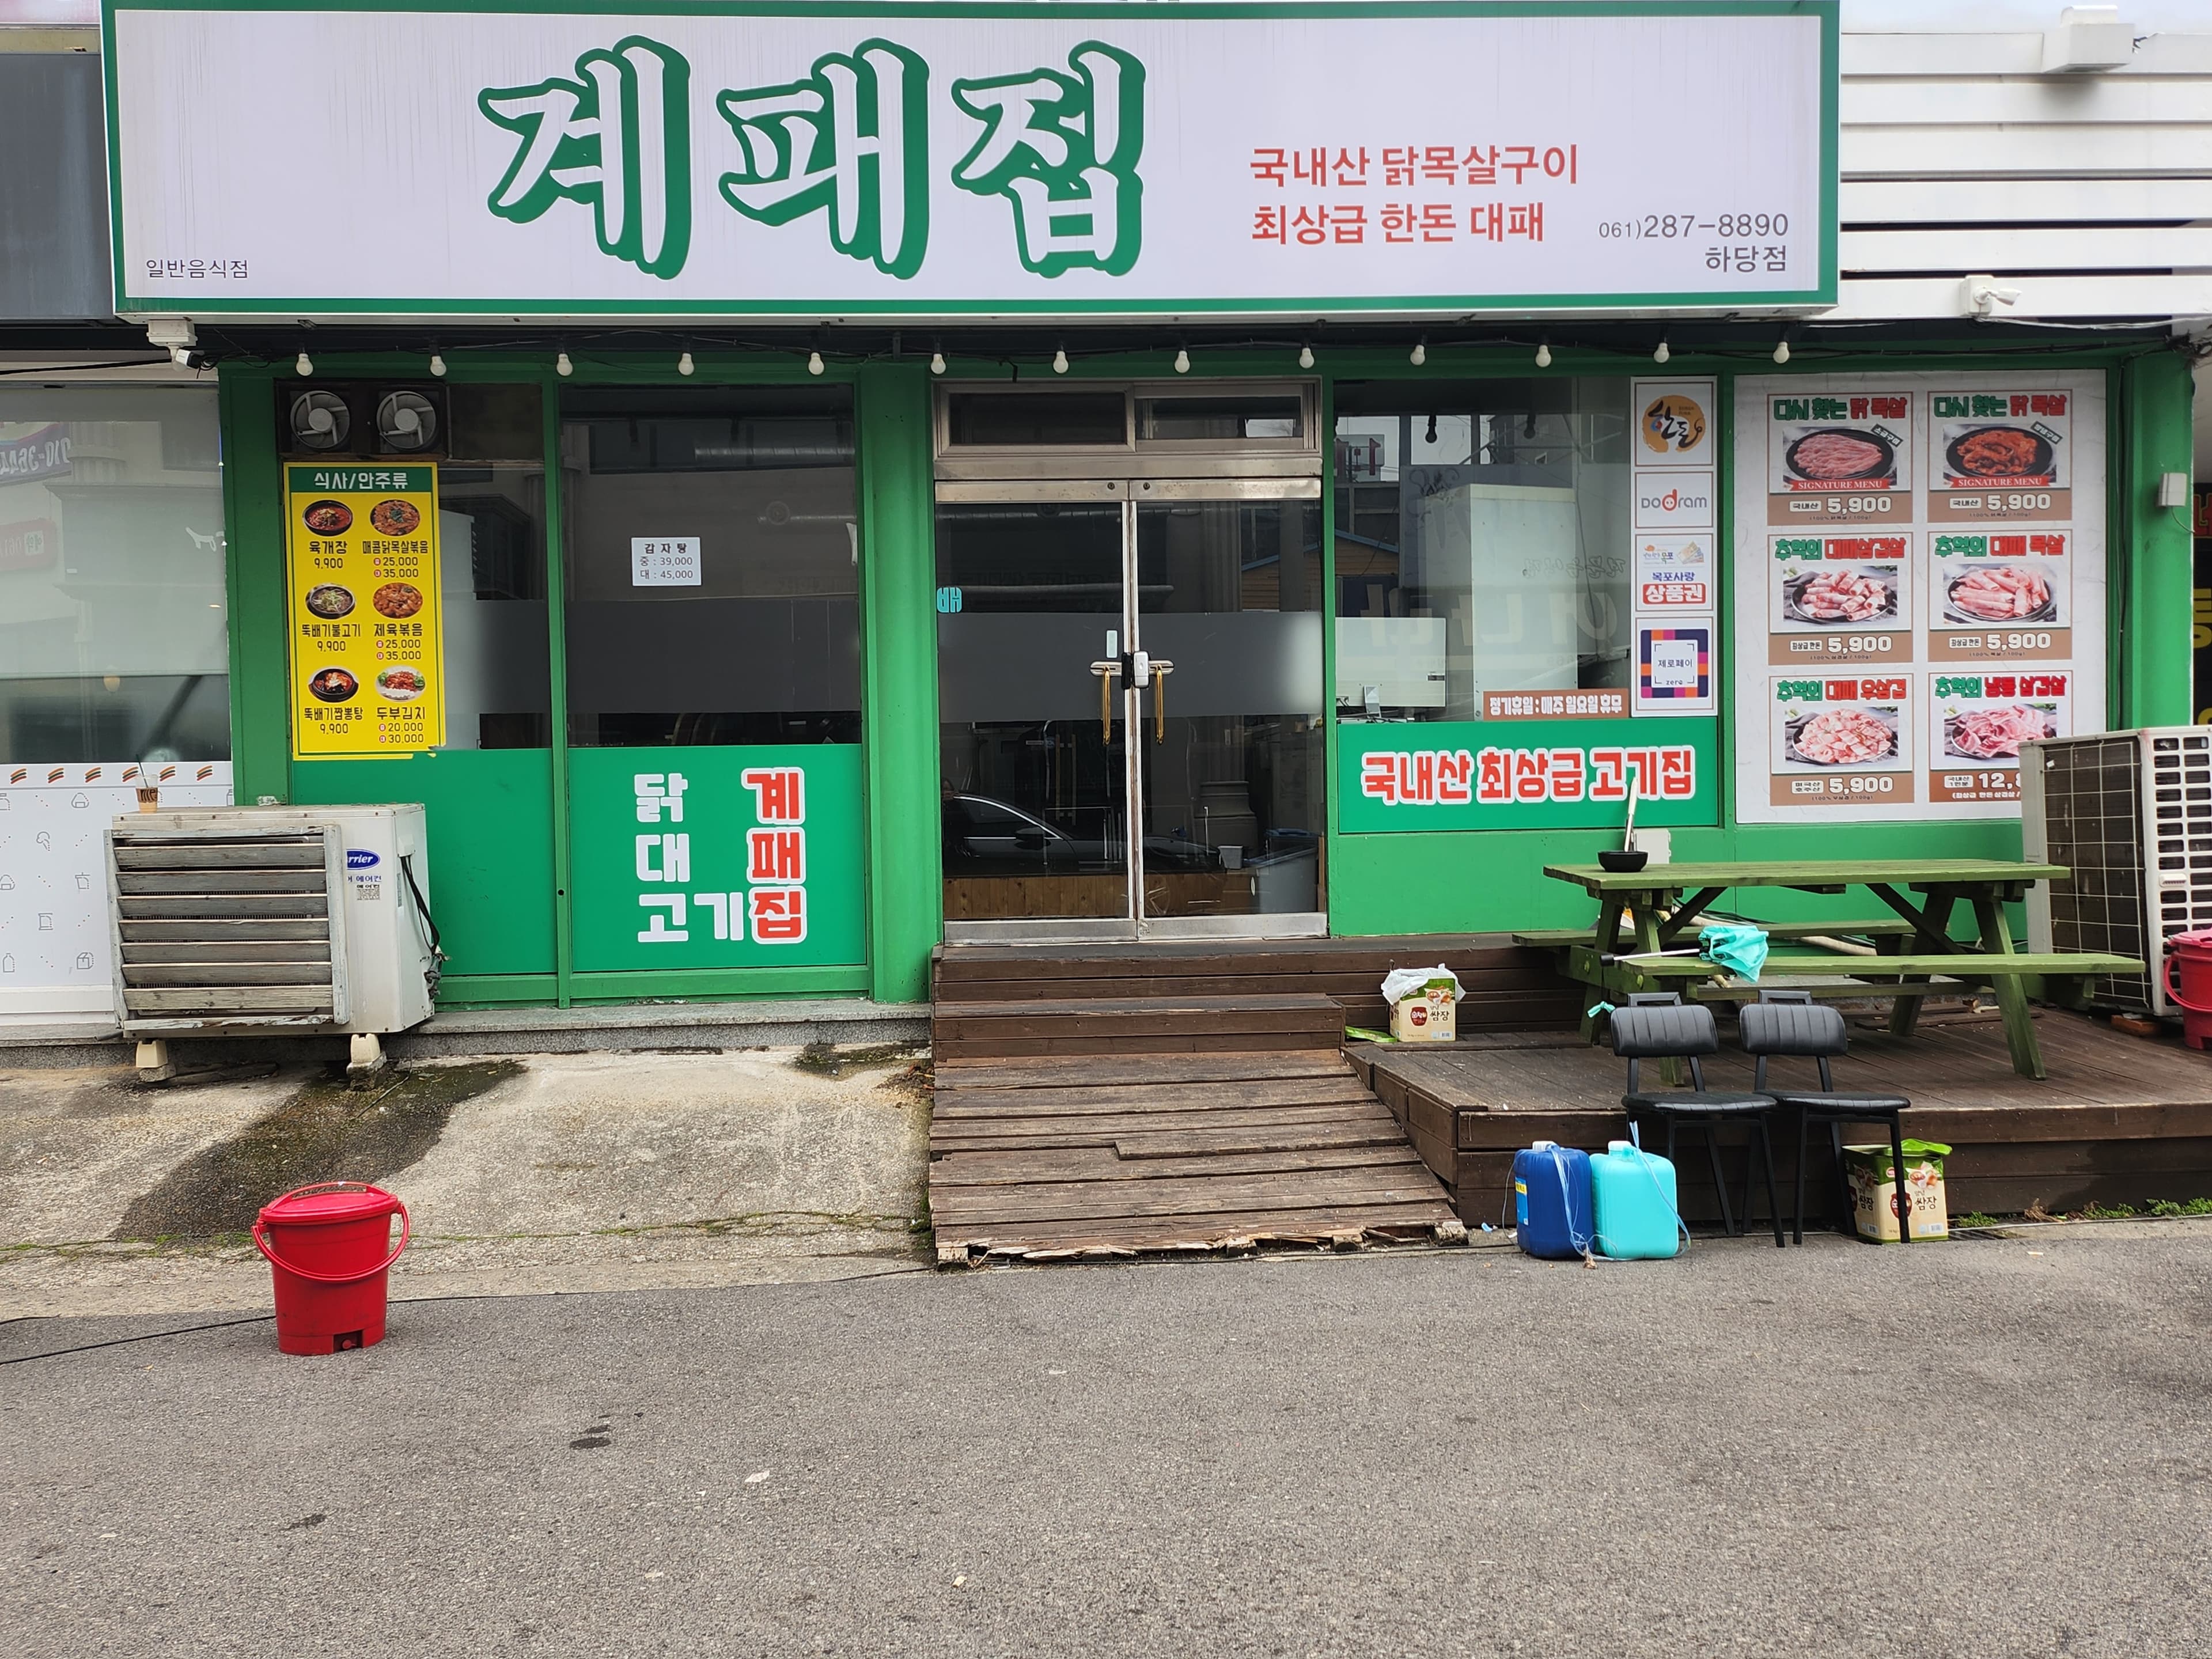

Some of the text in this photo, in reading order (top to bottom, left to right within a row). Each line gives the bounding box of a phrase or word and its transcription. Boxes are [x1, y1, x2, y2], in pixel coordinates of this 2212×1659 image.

[478, 35, 1145, 279] 계패집
[1250, 144, 1578, 187] 국내산 닭목살구이
[1252, 202, 1544, 244] 최상급 한돈 대패
[1705, 245, 1787, 272] 하당점
[146, 259, 249, 279] 일반음식점
[314, 472, 408, 489] 식사/안주류
[1798, 480, 1882, 489] SIGNATURE MENU
[1959, 477, 2041, 487] SIGNATURE MENU
[1827, 497, 1891, 514] 5,900
[1987, 494, 2051, 512] 5,900
[309, 540, 348, 554] 육개장
[639, 556, 649, 566] 중
[660, 557, 693, 566] 39,000
[640, 570, 649, 579] 대
[660, 570, 693, 579] 45,000
[1652, 571, 1695, 581] 목포사랑
[1646, 584, 1703, 603] 상품권
[302, 624, 361, 637] 뚝배기불고기
[374, 623, 423, 637] 제육볶음
[1828, 636, 1892, 654] 5,900
[1987, 632, 2051, 651] 5,900
[1657, 658, 1692, 668] 제로페이
[1566, 695, 1599, 714] 일요일
[1600, 694, 1622, 714] 휴무
[304, 707, 363, 721] 뚝배기짬뽕탕
[377, 707, 426, 719] 두부김치
[1362, 745, 1695, 806] 국내산 최상급 고기집
[1829, 777, 1893, 795] 5,900
[1914, 1195, 1937, 1211] 쌈장
